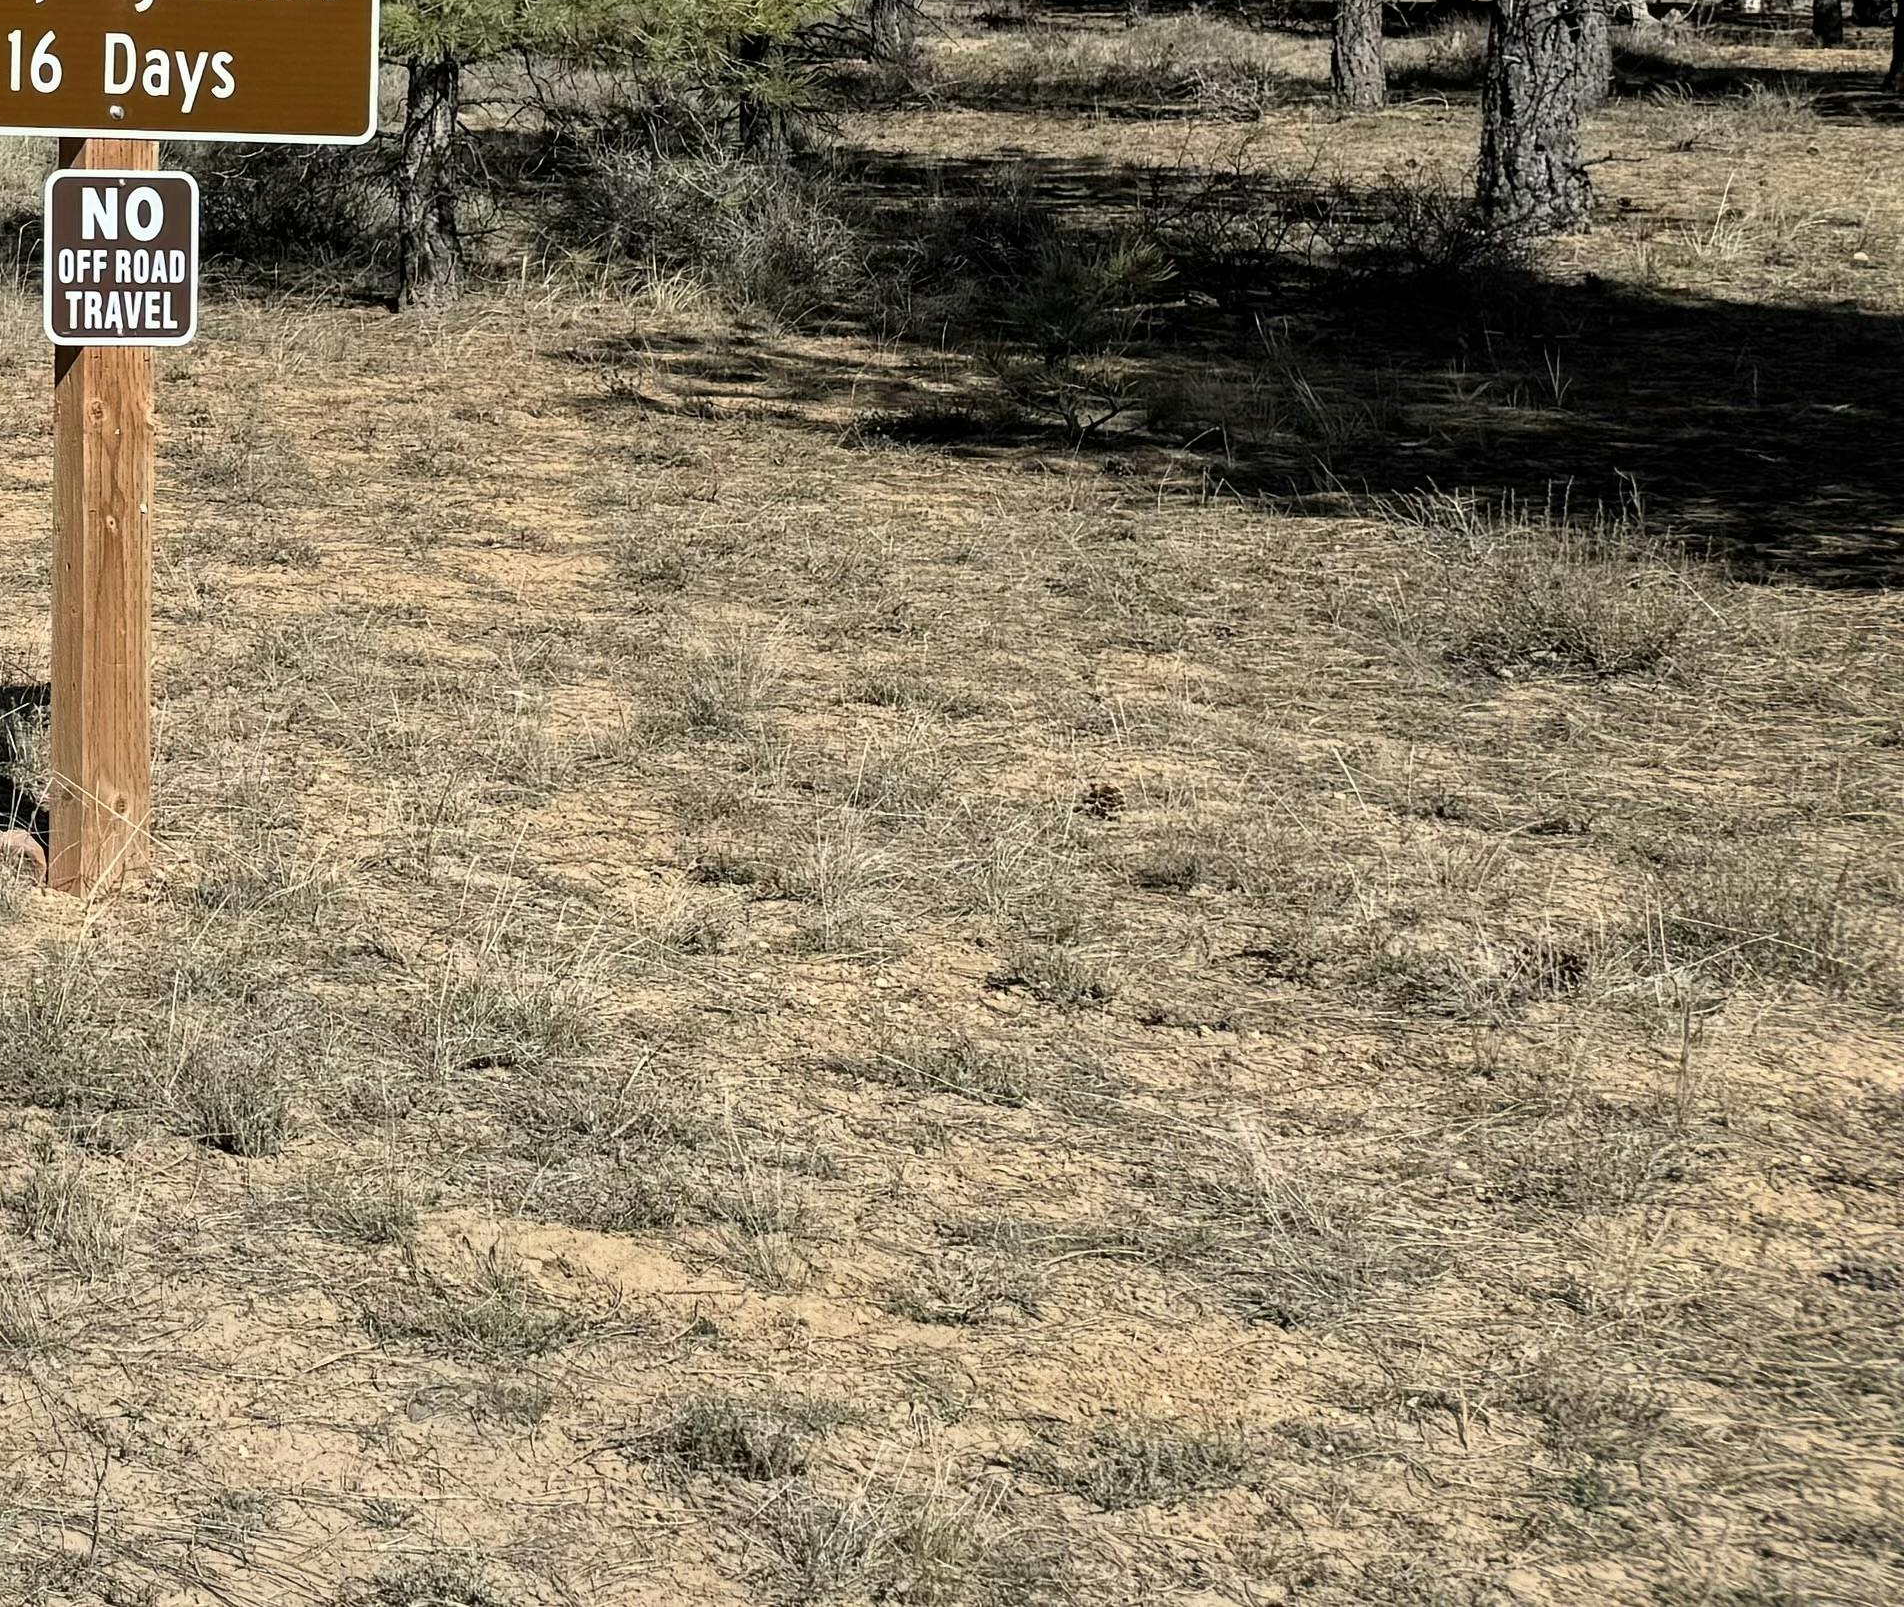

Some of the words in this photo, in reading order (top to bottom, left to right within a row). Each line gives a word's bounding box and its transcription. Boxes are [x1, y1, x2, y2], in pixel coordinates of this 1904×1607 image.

[7, 29, 63, 94] 16
[104, 32, 235, 113] Days
[81, 186, 164, 242] NO
[58, 248, 108, 284] OFF
[115, 248, 186, 284] ROAD
[65, 290, 178, 330] TRAVEL
